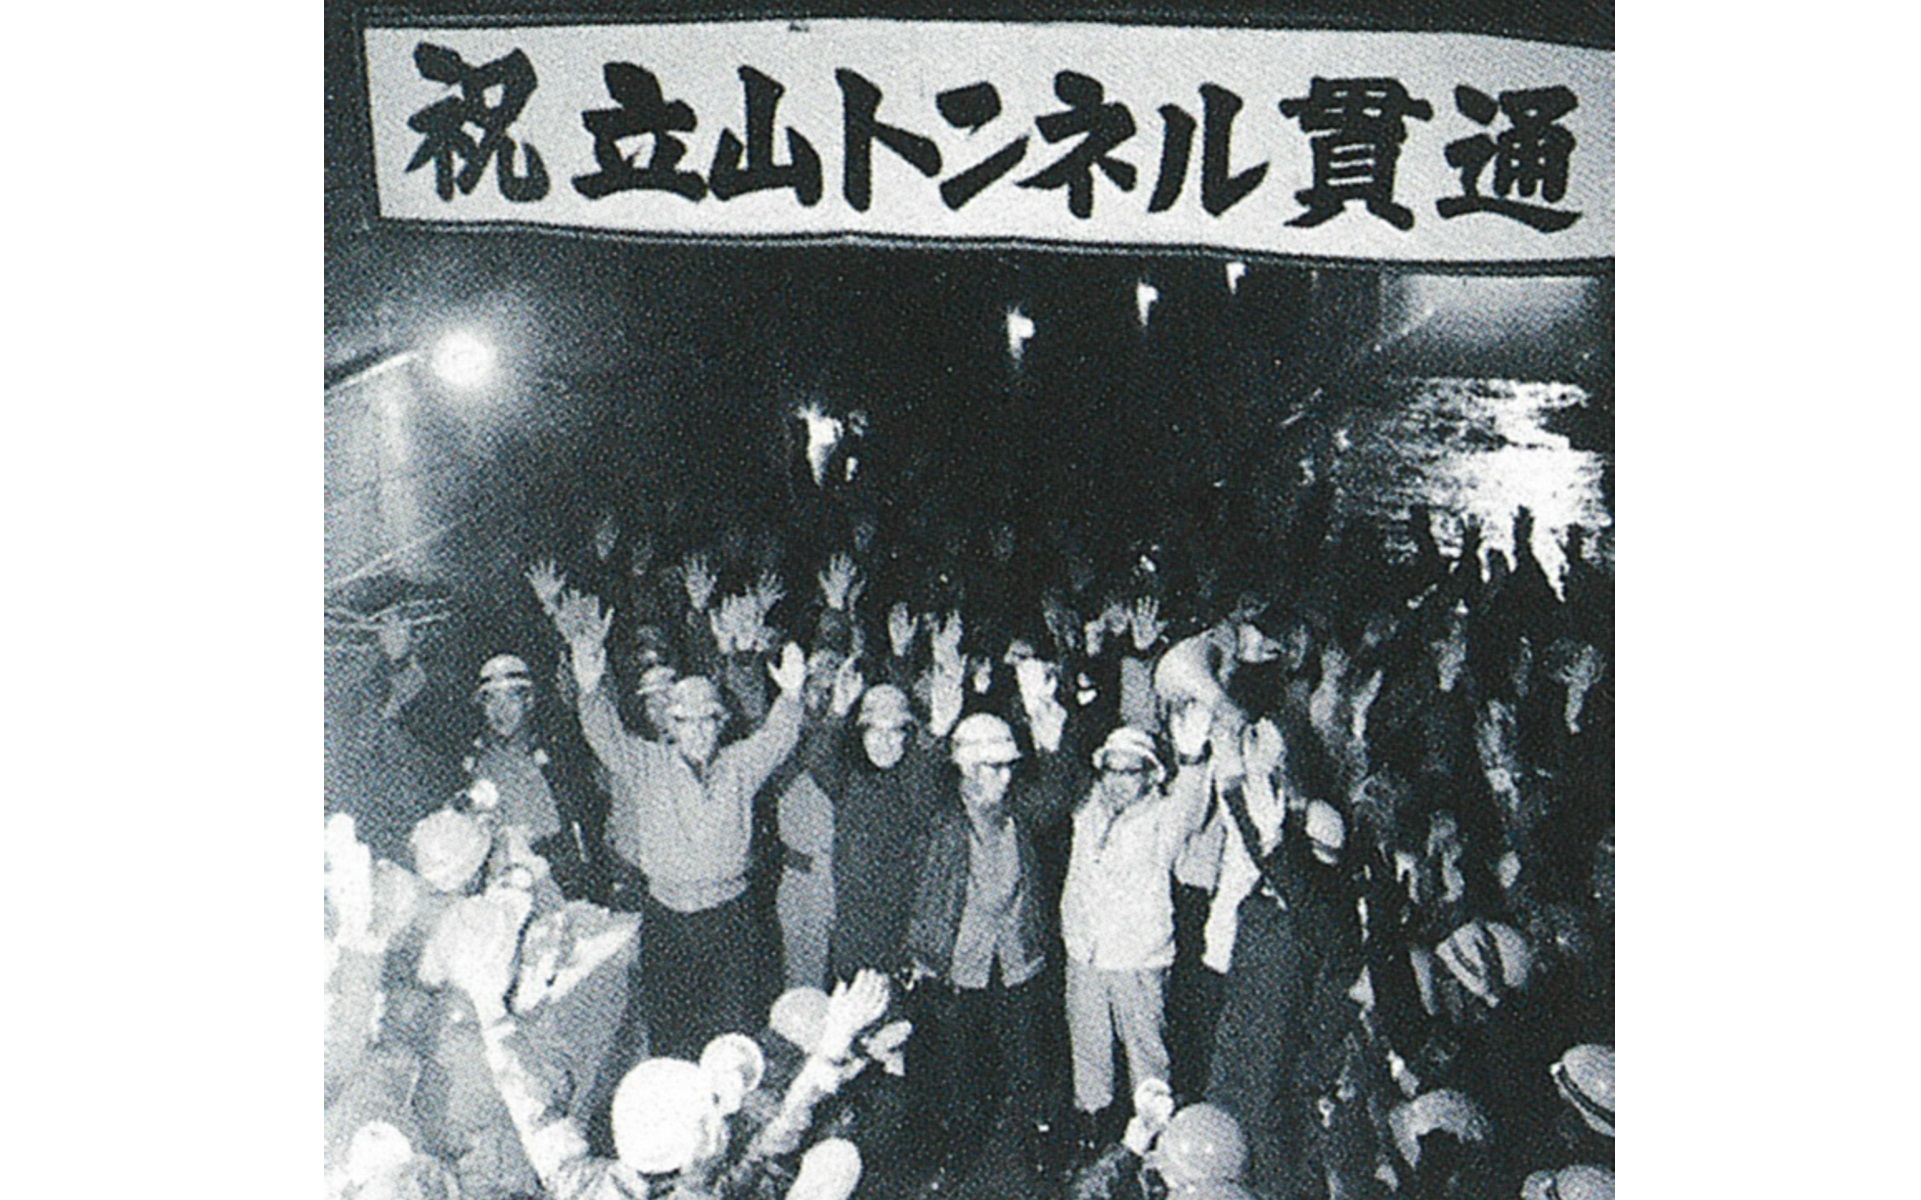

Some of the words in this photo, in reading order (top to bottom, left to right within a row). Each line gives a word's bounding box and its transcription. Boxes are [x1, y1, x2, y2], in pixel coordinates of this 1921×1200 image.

[404, 41, 1583, 234] 祝立山トンネル貫通
